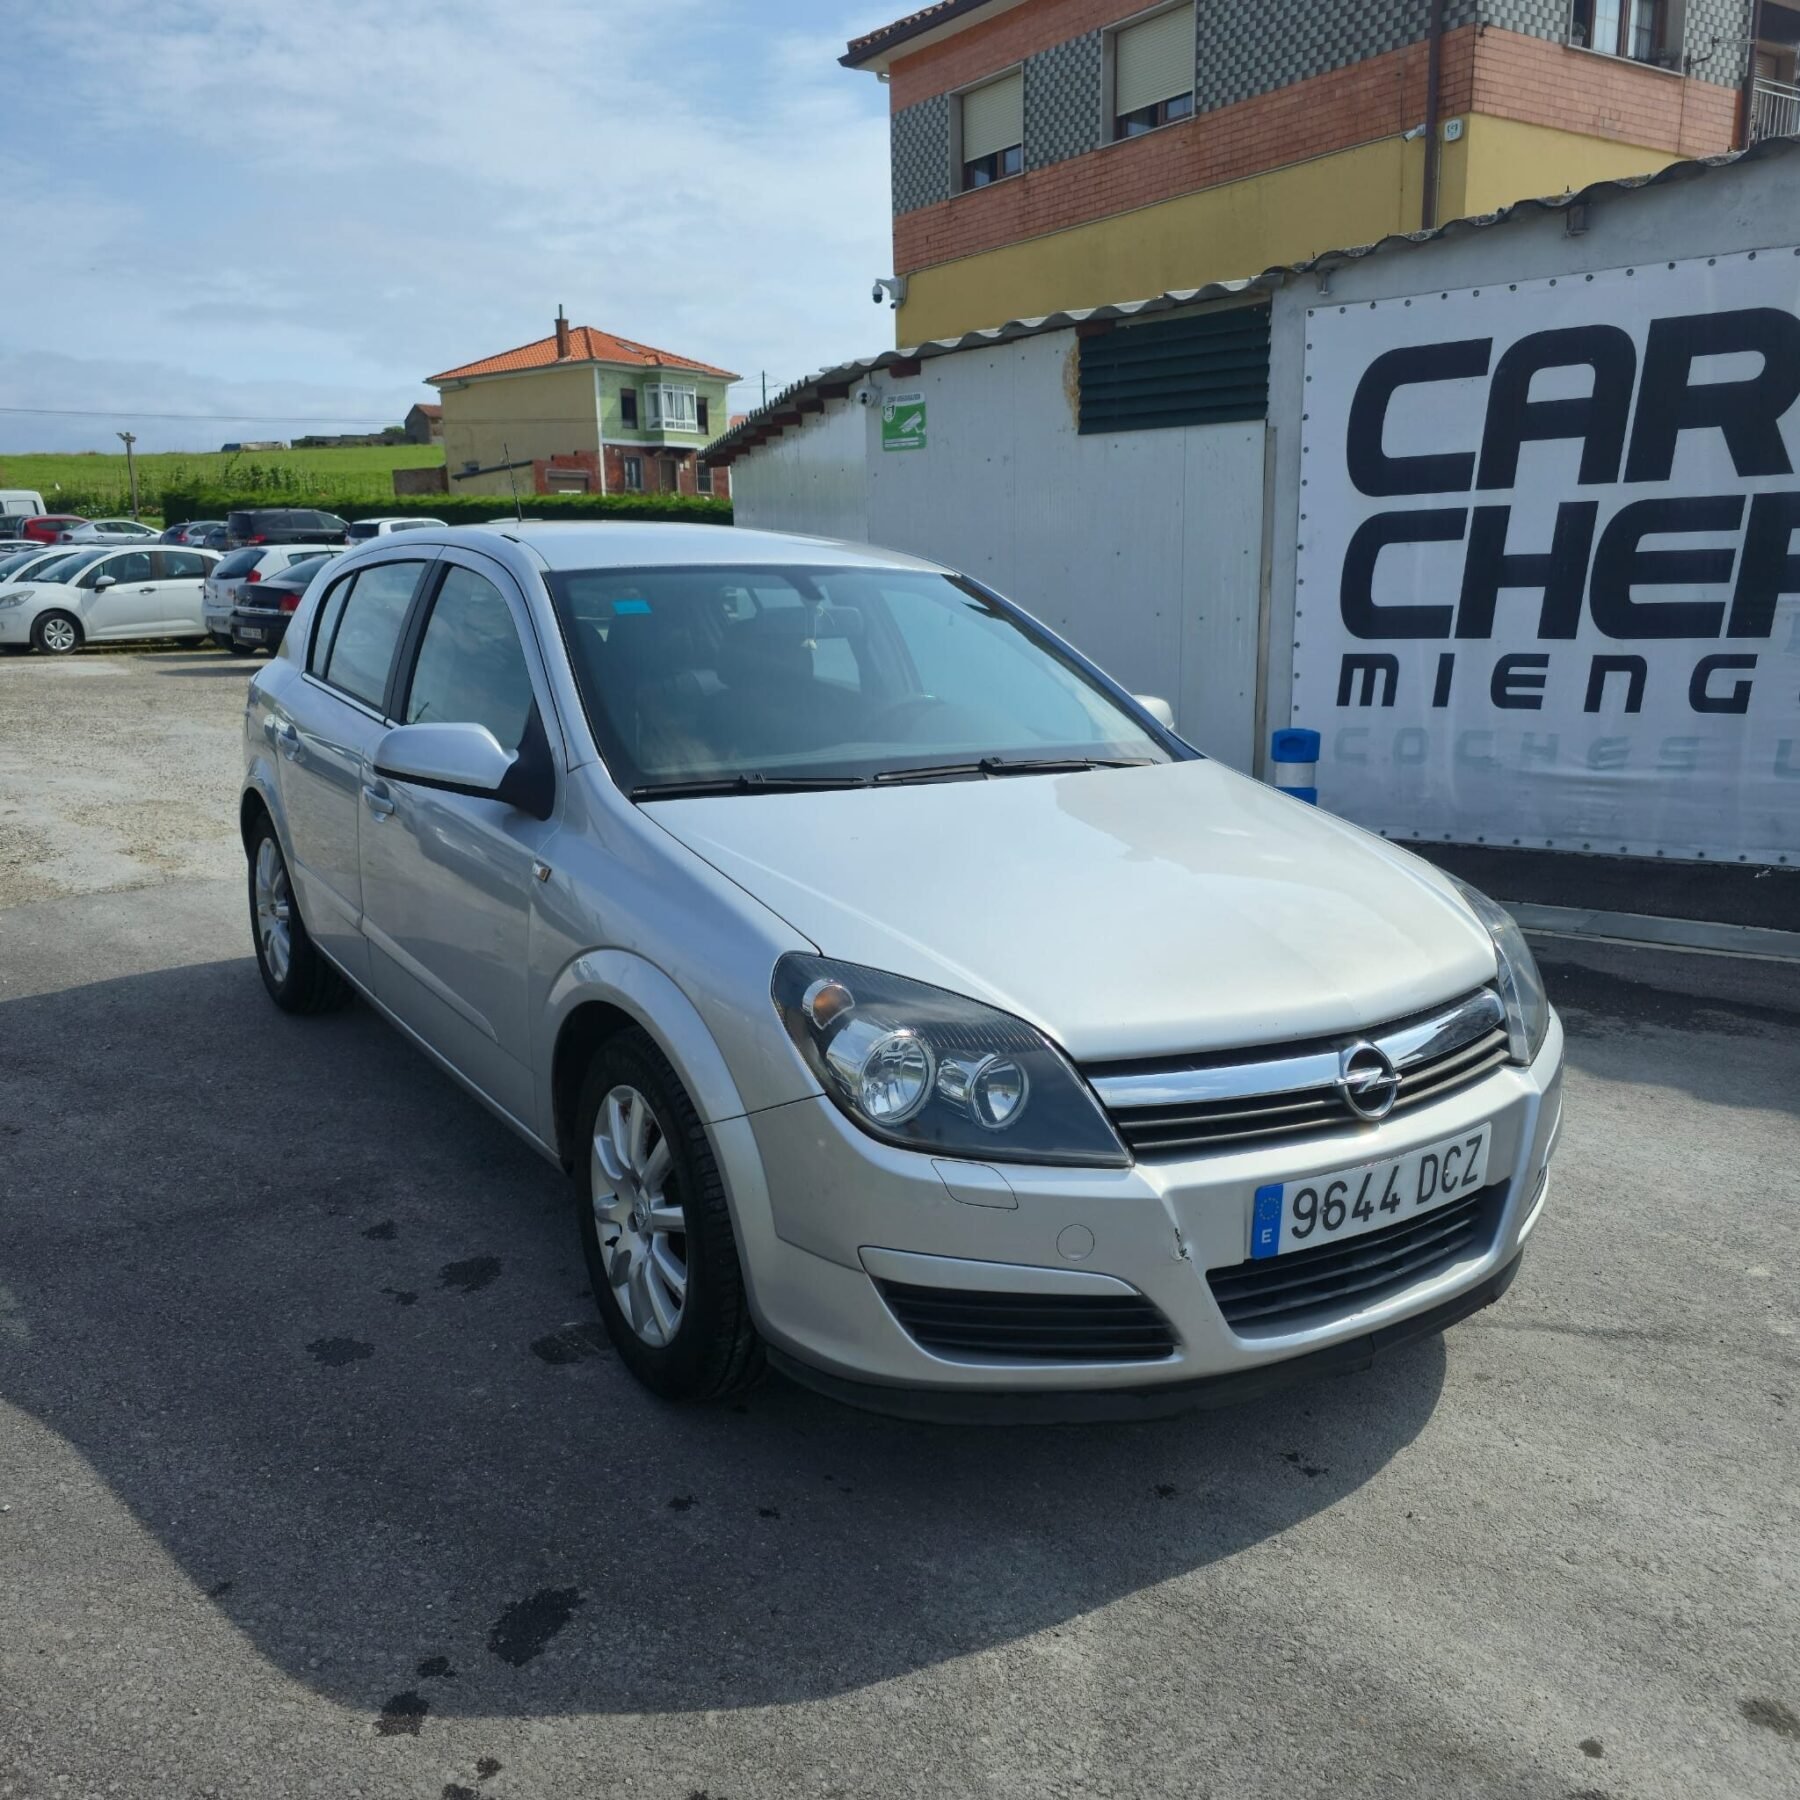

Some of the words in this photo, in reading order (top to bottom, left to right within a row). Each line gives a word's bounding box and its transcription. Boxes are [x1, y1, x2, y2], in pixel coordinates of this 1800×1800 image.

[1346, 307, 1800, 498] CAR
[1336, 653, 1800, 714] MIENG
[1334, 727, 1700, 773] COCHES
[1291, 1165, 1401, 1239] 9644
[1416, 1134, 1483, 1205] DCZ
[1261, 1228, 1273, 1244] E
